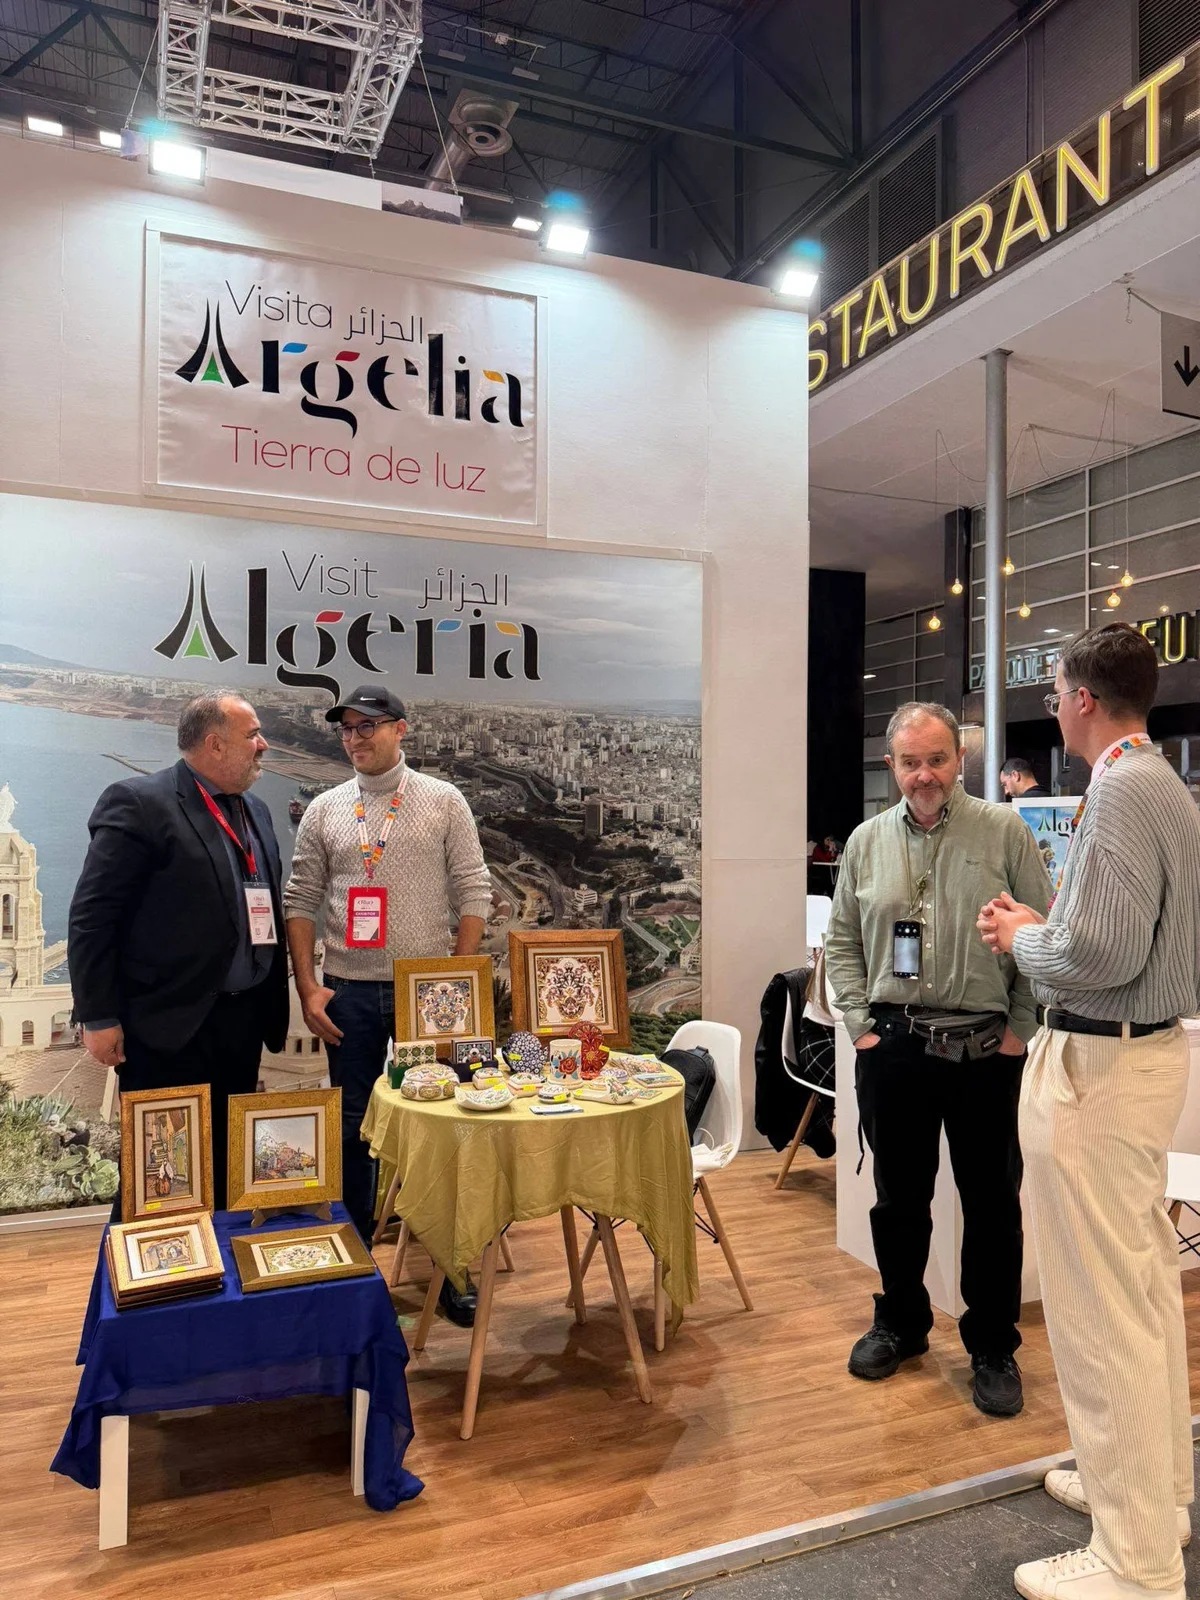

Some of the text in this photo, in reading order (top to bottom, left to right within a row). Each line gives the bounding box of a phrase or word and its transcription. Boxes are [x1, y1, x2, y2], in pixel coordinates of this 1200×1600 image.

[224, 279, 333, 330] Visita
[174, 297, 526, 440] Argelia
[221, 423, 487, 494] Tierra de luz
[282, 549, 380, 600] Visit
[153, 559, 542, 706] Algeria
[1038, 809, 1077, 838] Alg
